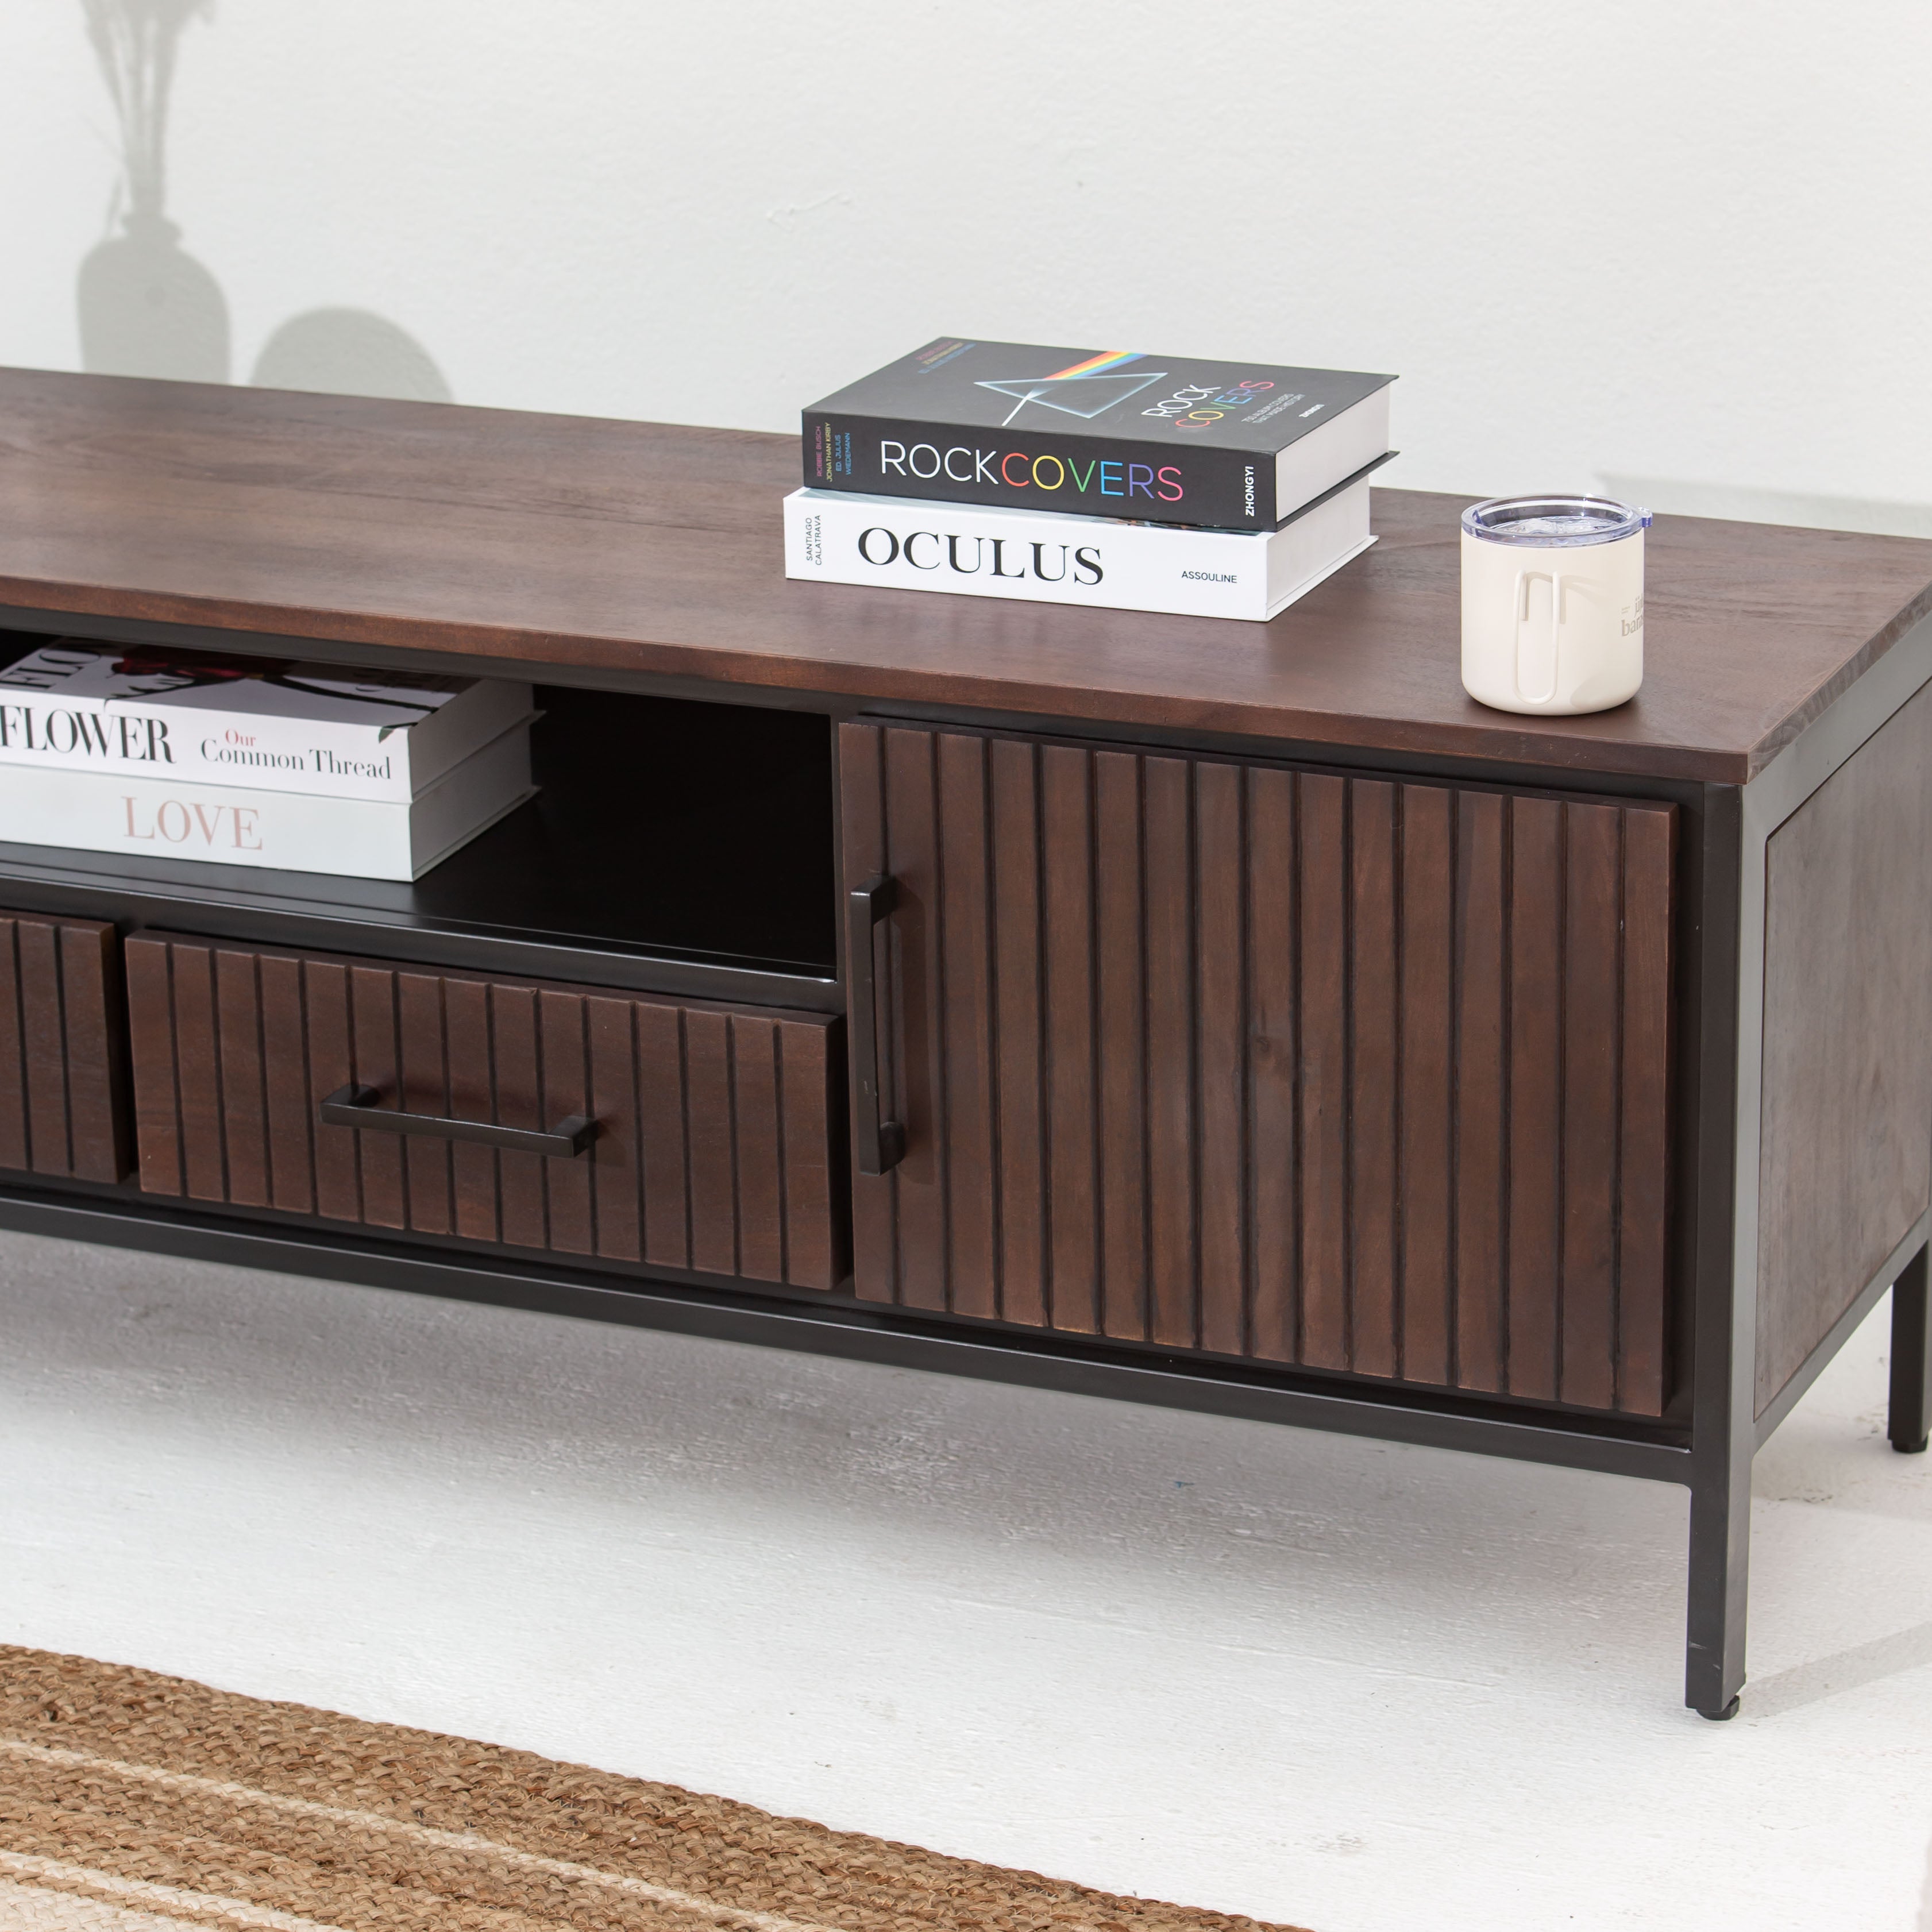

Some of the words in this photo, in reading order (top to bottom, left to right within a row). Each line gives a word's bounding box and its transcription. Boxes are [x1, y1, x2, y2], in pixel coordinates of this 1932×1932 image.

[1141, 384, 1221, 418] ROCK
[1175, 380, 1274, 427] COVERS
[1244, 465, 1254, 517] ZHONGYI
[858, 527, 1103, 585] OCULUS
[1181, 570, 1237, 584] ASSOULINE
[0, 705, 176, 764] FLOWER
[225, 728, 256, 746] Our
[201, 739, 304, 770] Common
[309, 749, 391, 780] Thread
[121, 796, 263, 850] LOVE
